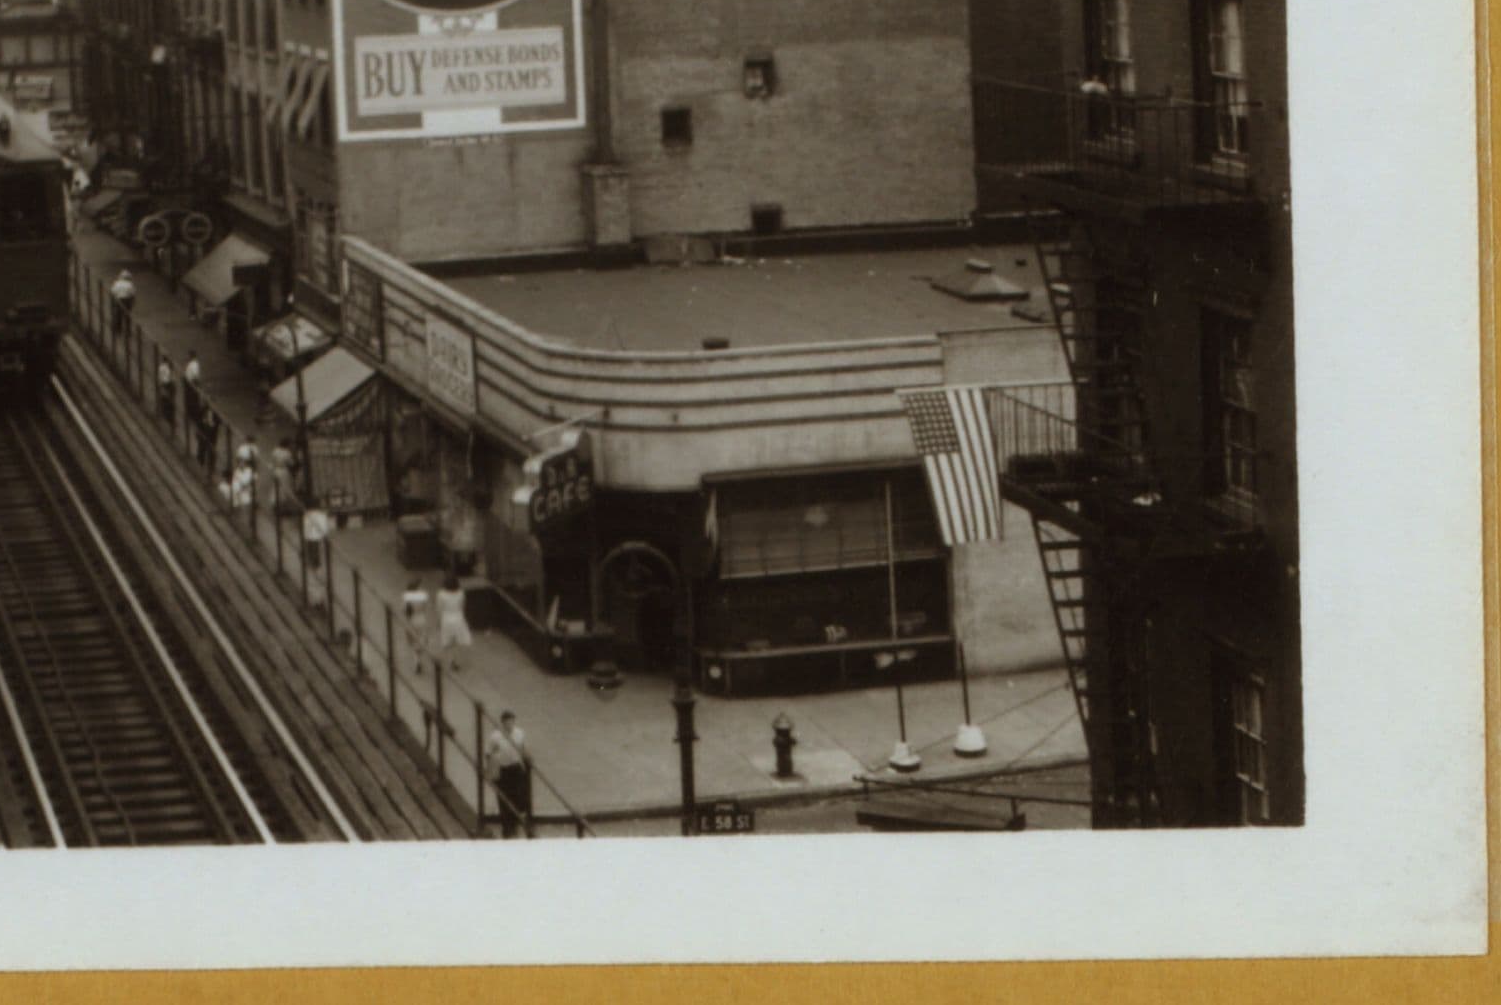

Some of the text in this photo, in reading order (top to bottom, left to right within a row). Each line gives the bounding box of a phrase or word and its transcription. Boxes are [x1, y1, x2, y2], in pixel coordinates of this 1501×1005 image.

[431, 42, 560, 69] DEFENSE BONDS
[363, 50, 426, 100] BUY
[443, 68, 553, 95] AND STAMPS
